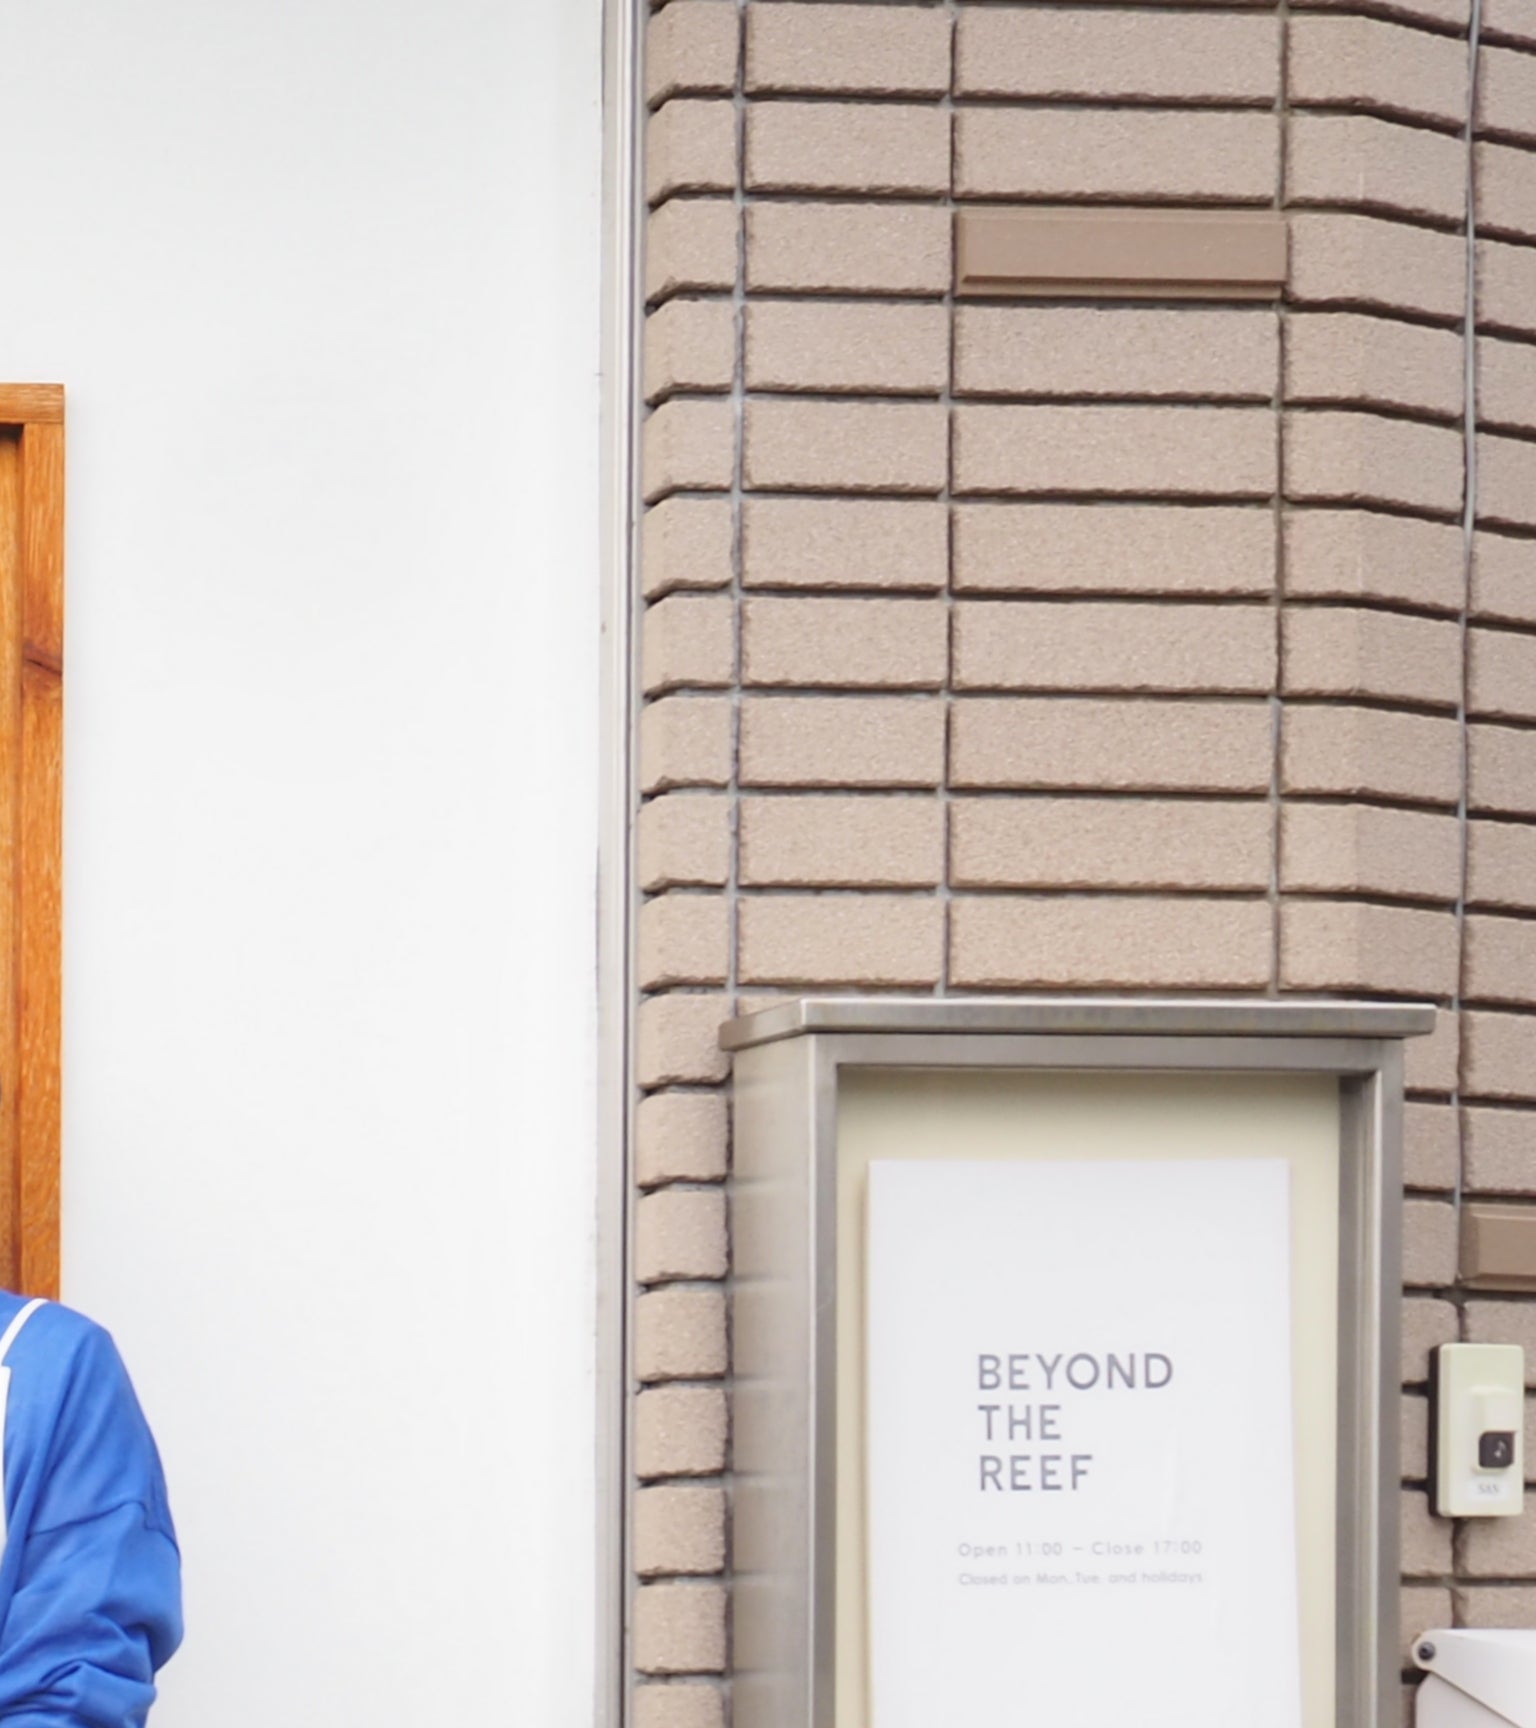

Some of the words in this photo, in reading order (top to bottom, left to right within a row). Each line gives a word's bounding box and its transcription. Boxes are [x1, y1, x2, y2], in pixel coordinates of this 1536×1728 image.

[978, 1352, 1173, 1391] BEYOND
[977, 1404, 1062, 1441] THE
[979, 1454, 1093, 1492] REEF
[957, 1542, 1008, 1559] Open
[1091, 1540, 1145, 1556] Close
